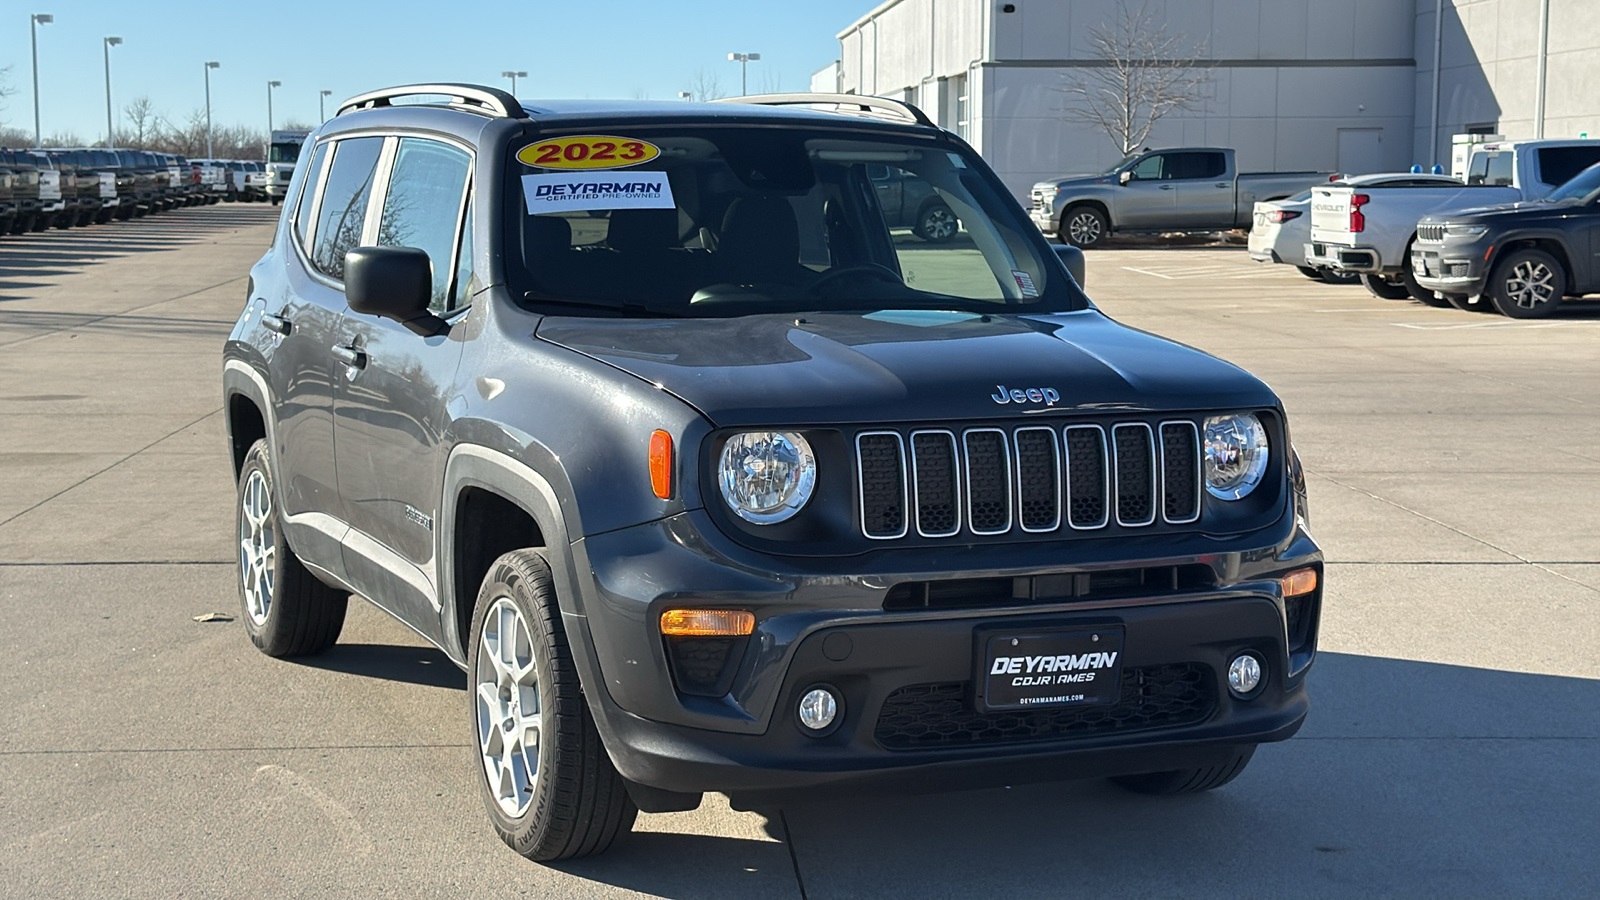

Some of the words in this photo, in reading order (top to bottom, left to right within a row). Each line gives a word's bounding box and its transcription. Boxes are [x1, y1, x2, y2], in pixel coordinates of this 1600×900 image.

[534, 142, 646, 164] 2023
[535, 182, 662, 196] DEYARMAN
[991, 384, 1060, 407] Jeep
[990, 651, 1118, 675] DEYARMAN
[1057, 672, 1096, 685] AMES
[1020, 694, 1084, 705] DEYARMANAMES.COM
